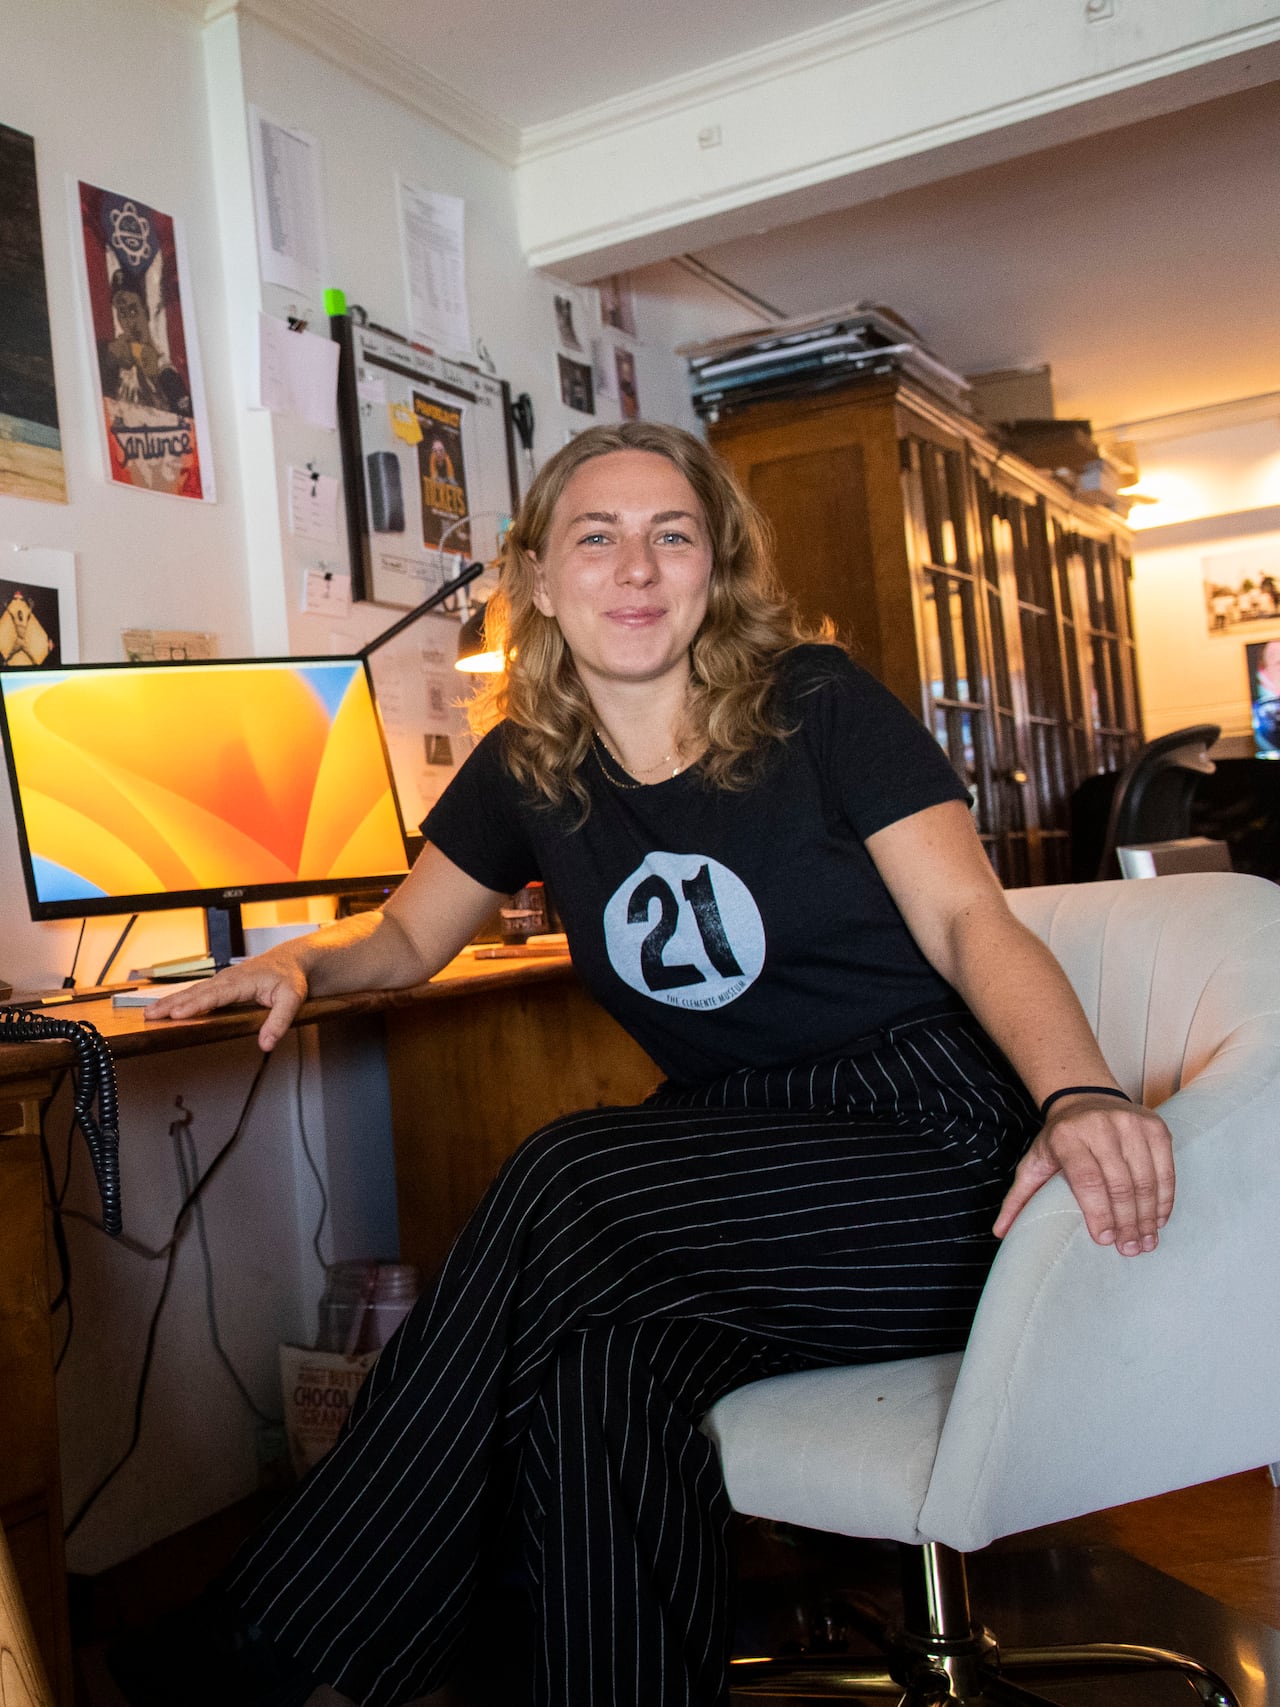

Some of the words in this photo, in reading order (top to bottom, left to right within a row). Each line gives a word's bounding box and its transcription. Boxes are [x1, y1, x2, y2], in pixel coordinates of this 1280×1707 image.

[627, 863, 746, 992] 21
[666, 994, 679, 1003] THE
[681, 996, 717, 1009] CLEMENTE
[717, 980, 747, 1002] MUSEUM
